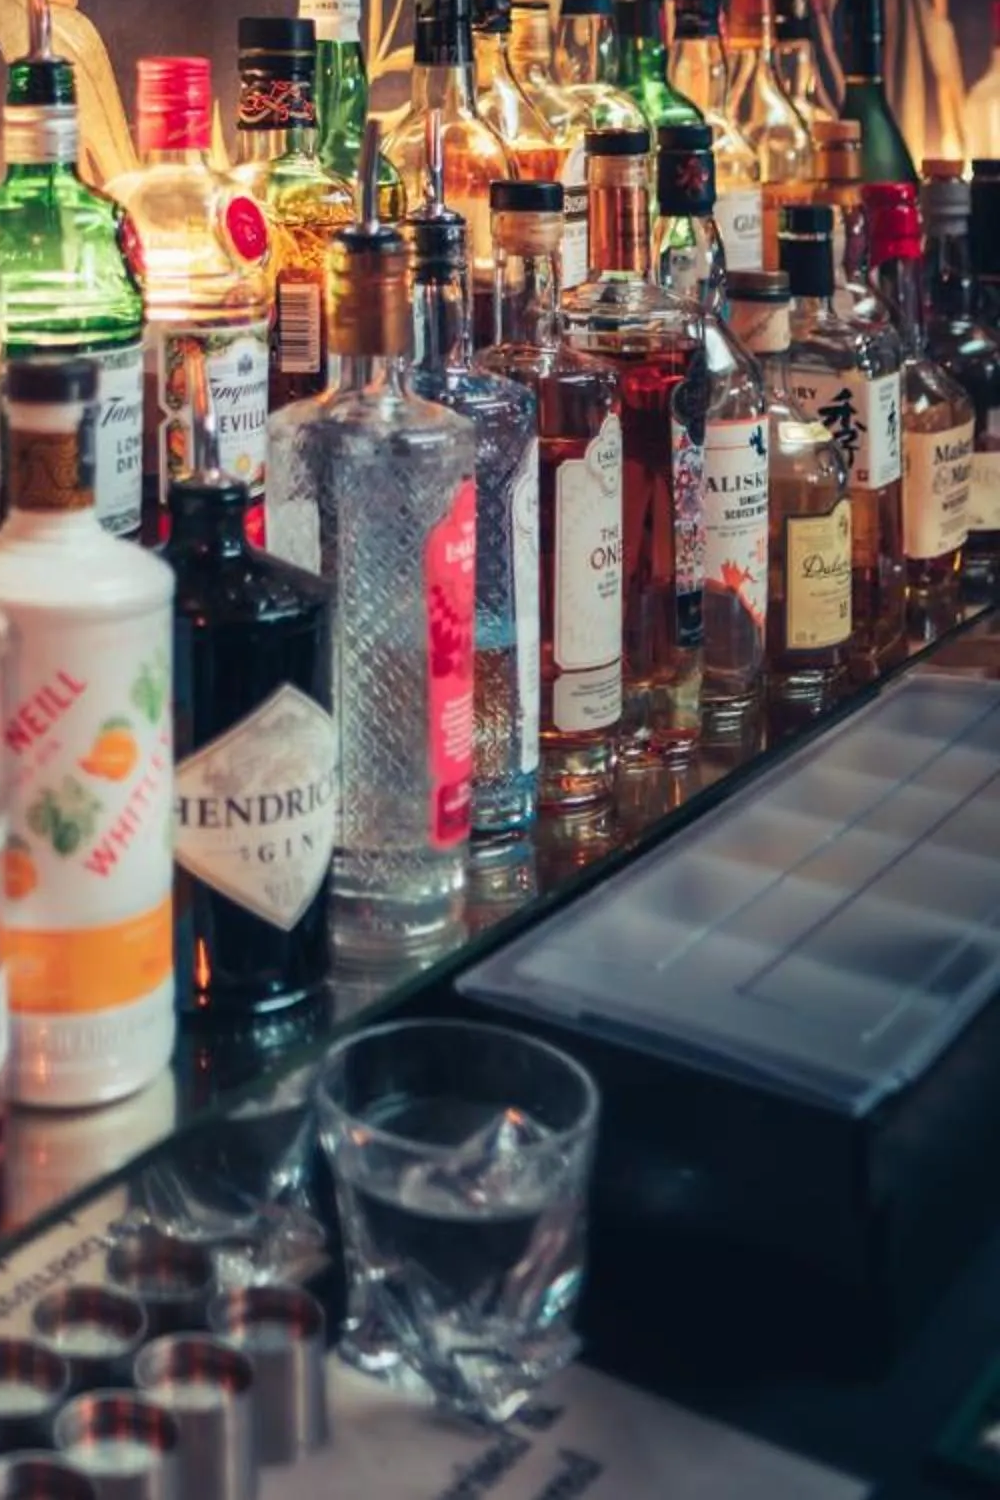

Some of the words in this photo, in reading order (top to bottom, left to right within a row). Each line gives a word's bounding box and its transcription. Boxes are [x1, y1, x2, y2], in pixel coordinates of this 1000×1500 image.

[705, 471, 764, 494] ALISK
[4, 669, 87, 754] NEILL
[175, 777, 335, 828] HENDRIC
